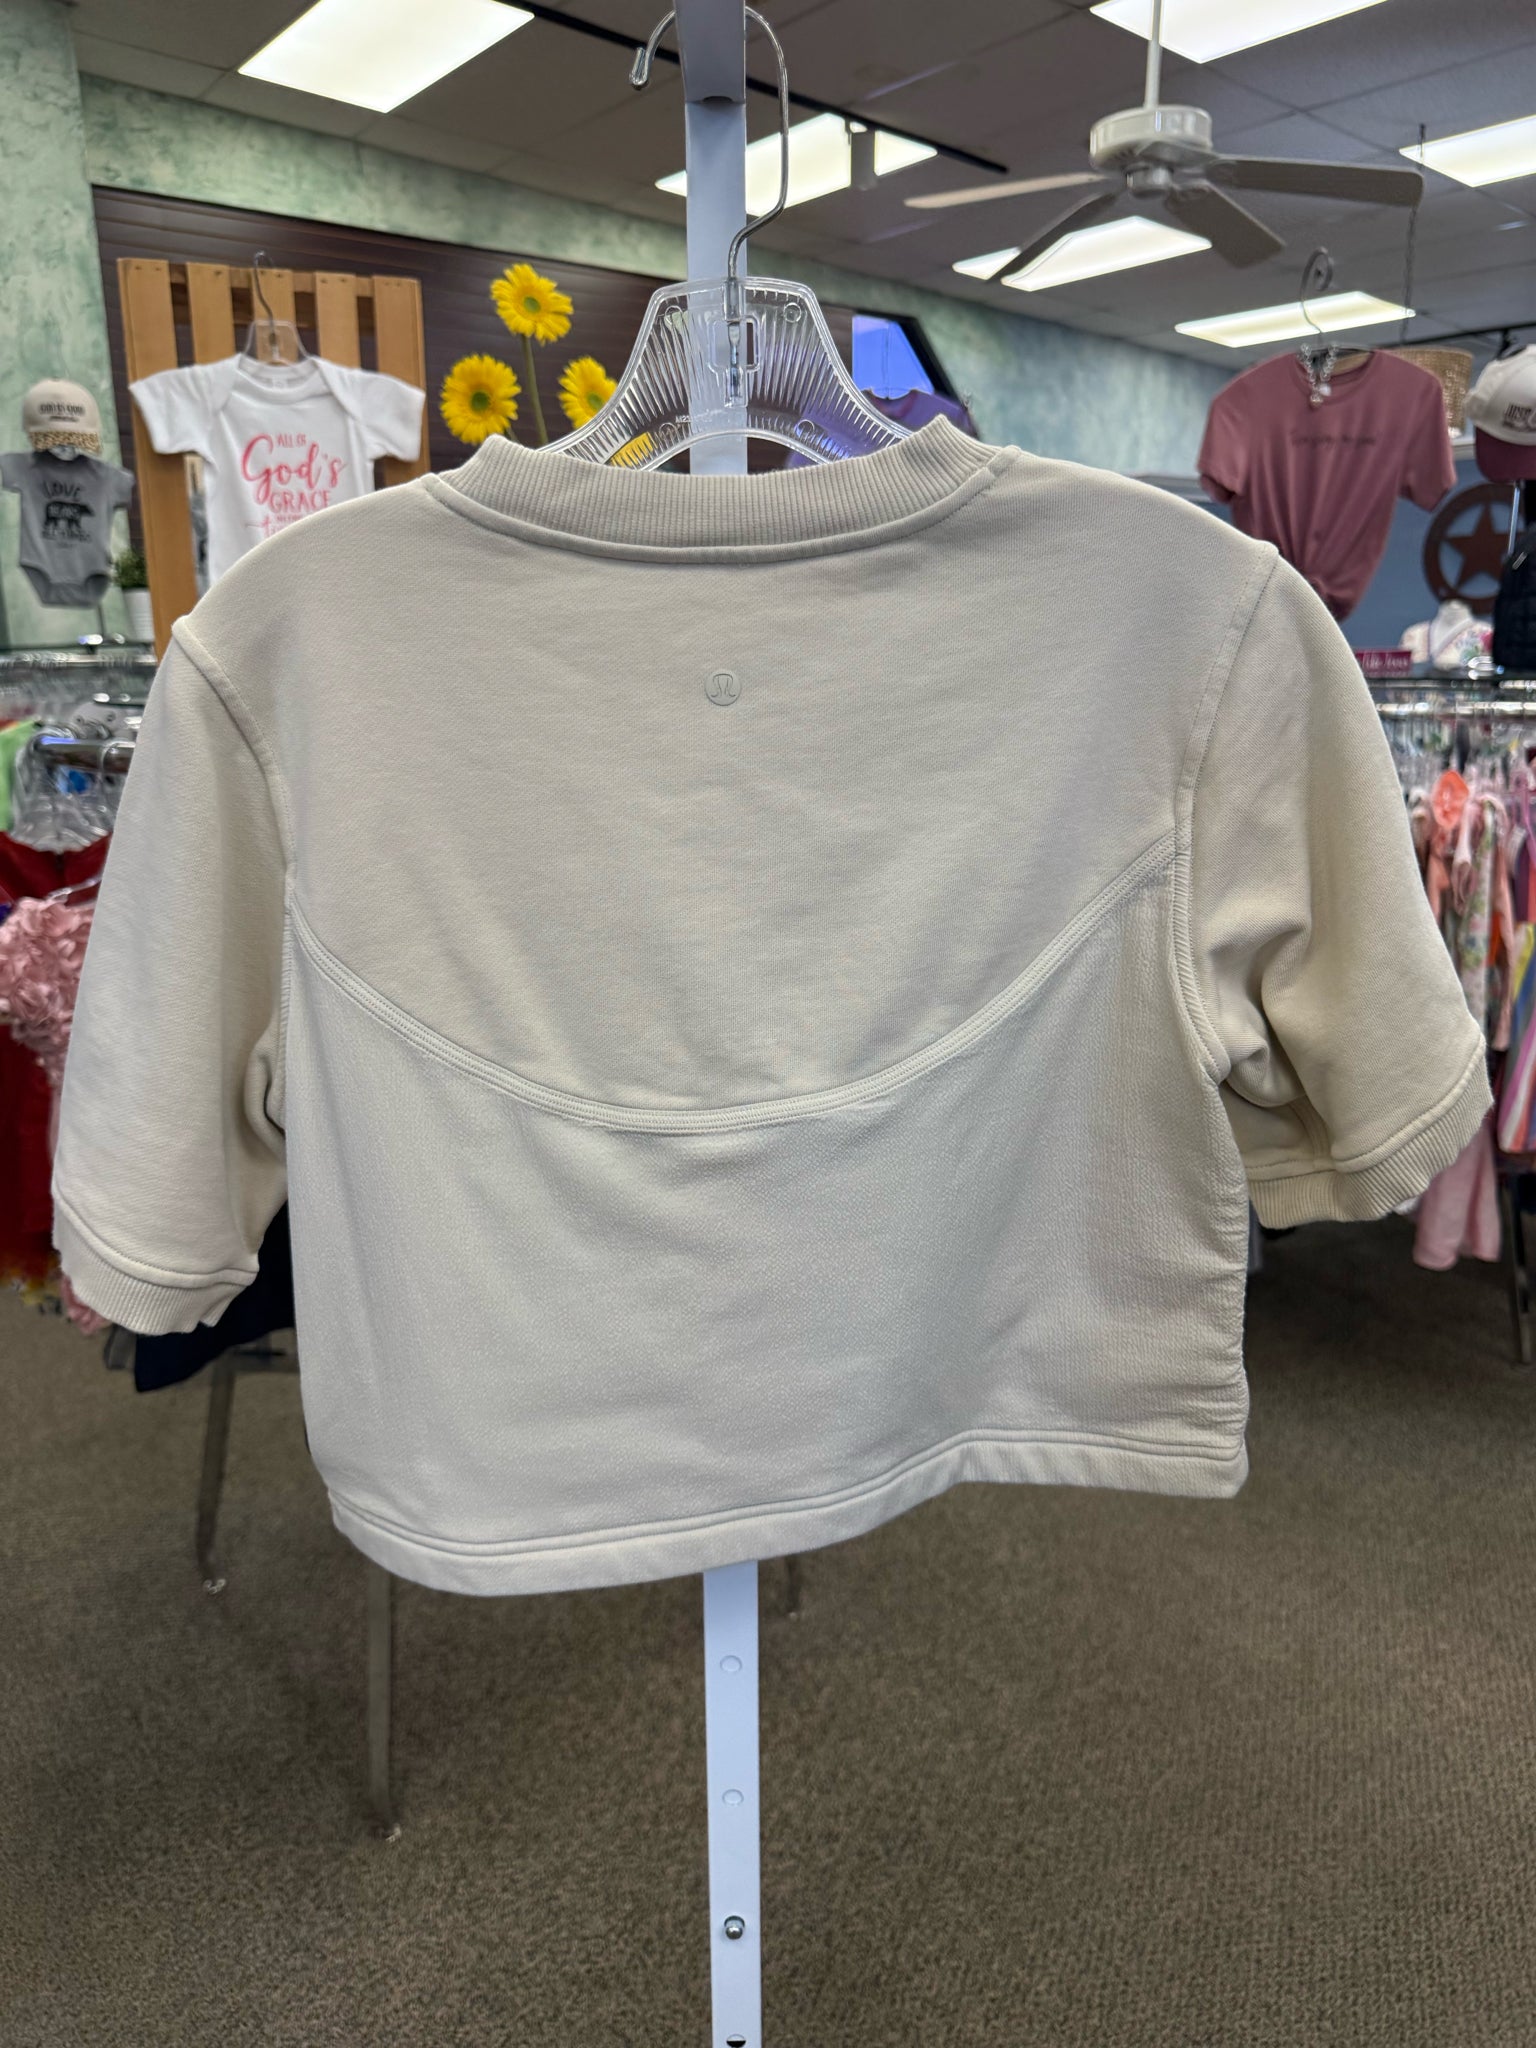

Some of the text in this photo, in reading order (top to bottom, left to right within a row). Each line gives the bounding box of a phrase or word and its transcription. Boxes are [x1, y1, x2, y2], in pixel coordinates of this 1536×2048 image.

[277, 433, 293, 448] ALL
[242, 432, 348, 505] God's
[269, 489, 330, 513] GRACE
